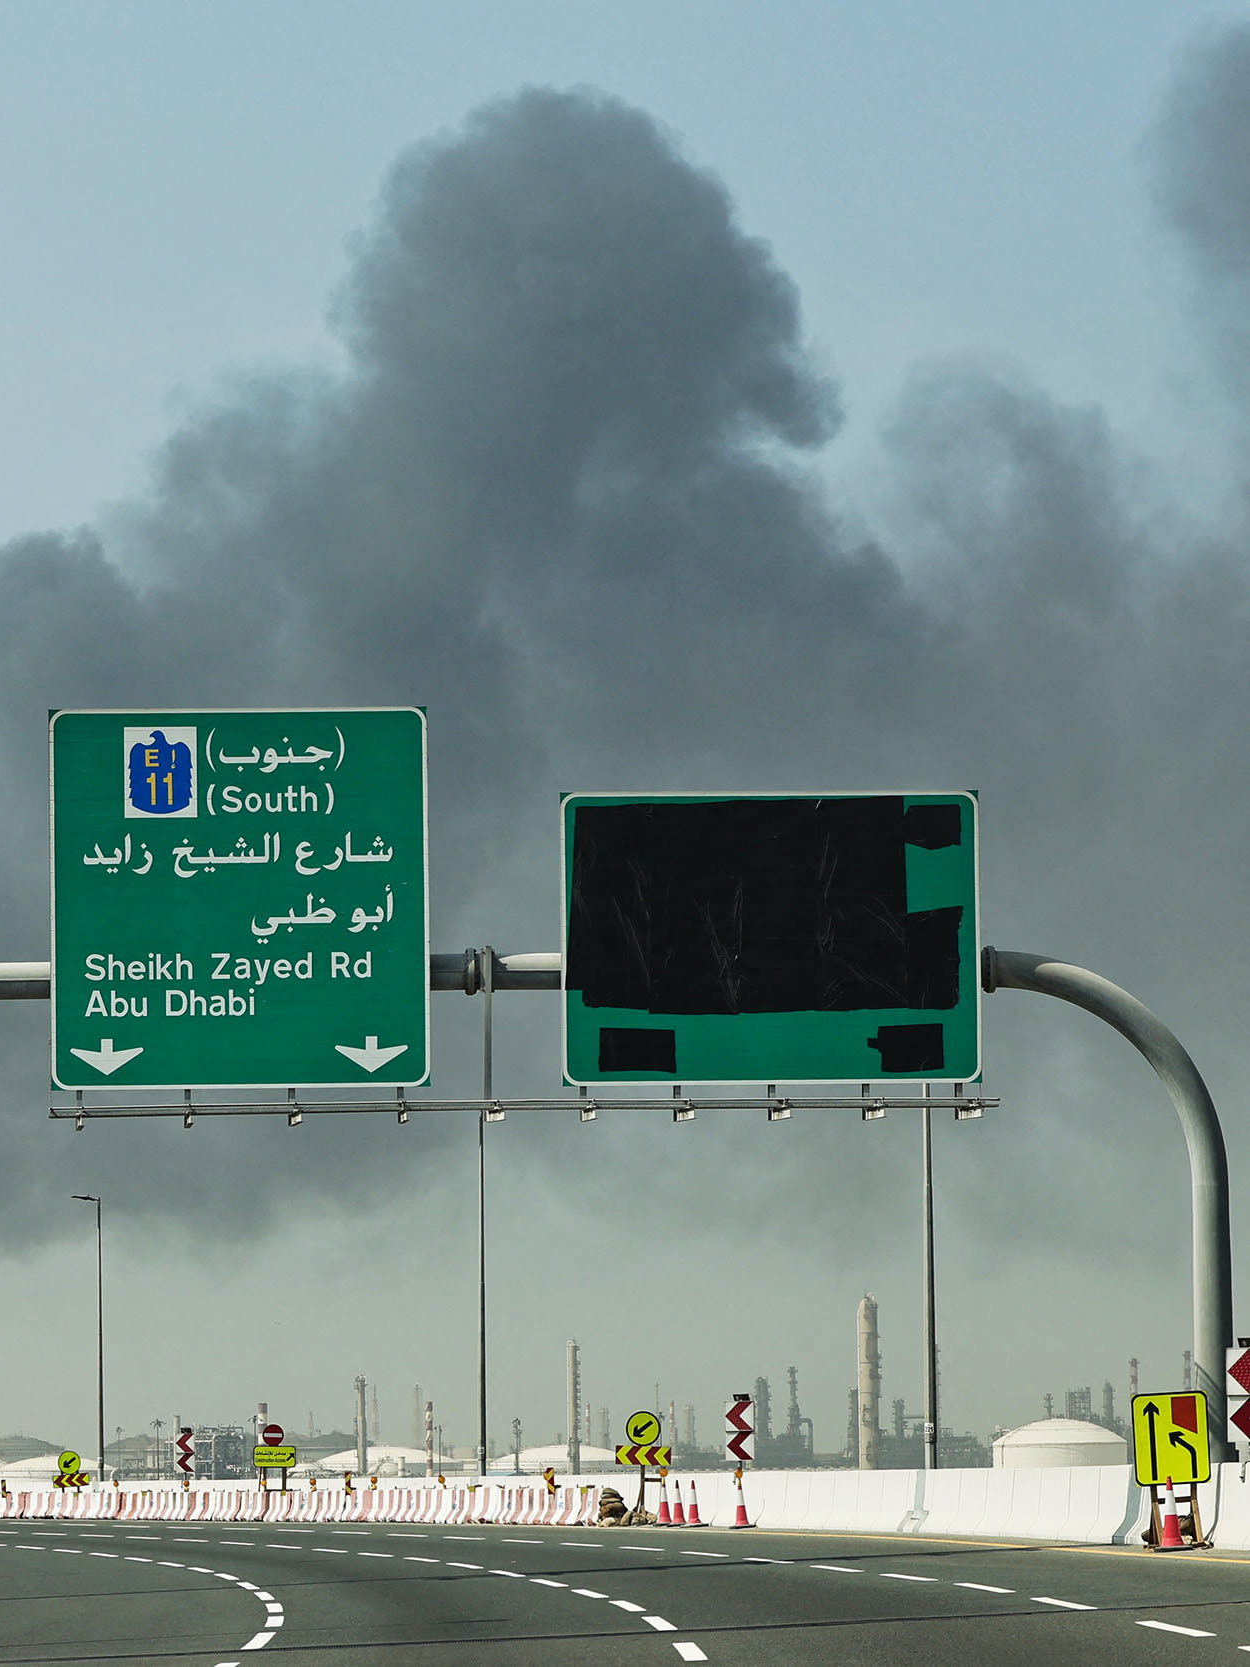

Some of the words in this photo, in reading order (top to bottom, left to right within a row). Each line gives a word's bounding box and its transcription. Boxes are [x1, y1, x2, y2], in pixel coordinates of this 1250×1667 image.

[145, 749, 160, 767] E
[205, 726, 346, 774] (جنوب)
[146, 772, 175, 806] 11
[206, 783, 335, 816] (South)
[83, 833, 153, 875] زايد
[171, 831, 281, 878] الشيخ
[294, 831, 394, 876] شارع
[251, 892, 337, 944] ظبي
[347, 884, 394, 933] أبو
[84, 952, 193, 981] Sheikh
[211, 951, 313, 985] Zayed
[330, 951, 372, 979] Rd
[84, 990, 148, 1017] Abu
[165, 988, 256, 1017] Dhabi
